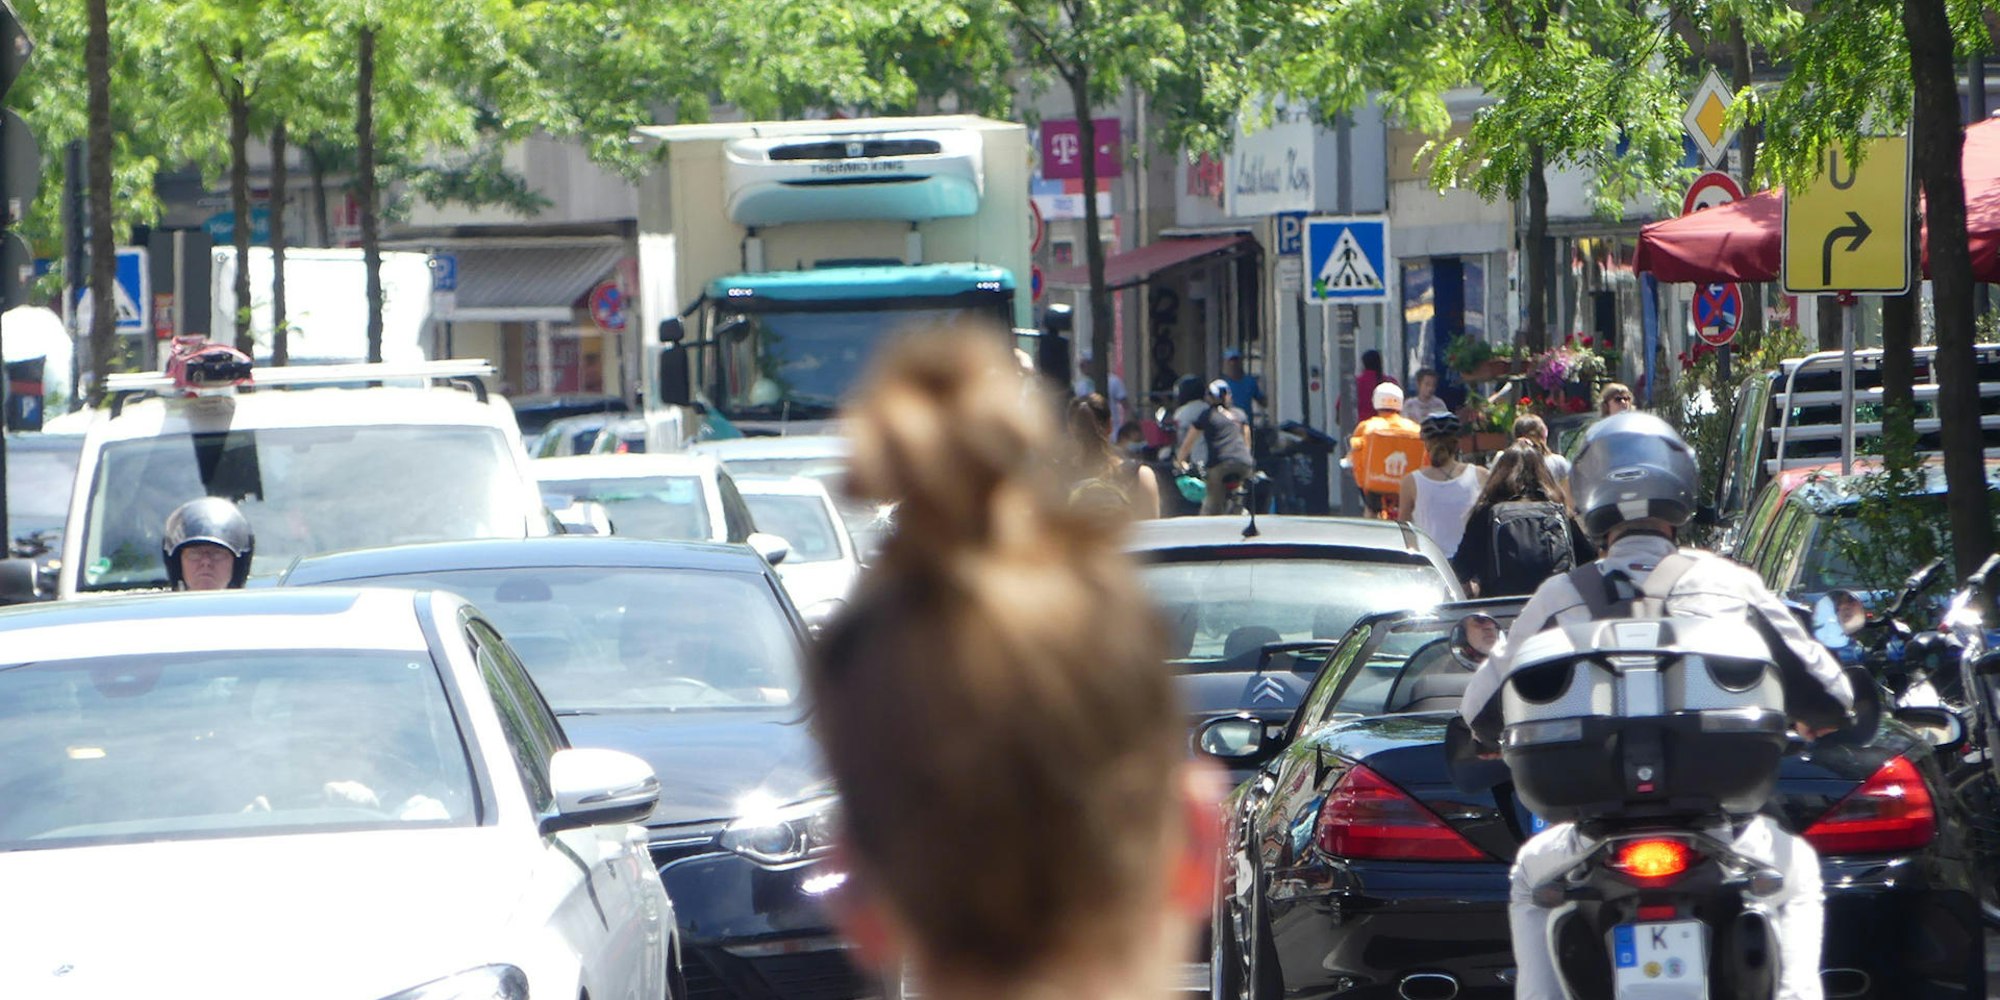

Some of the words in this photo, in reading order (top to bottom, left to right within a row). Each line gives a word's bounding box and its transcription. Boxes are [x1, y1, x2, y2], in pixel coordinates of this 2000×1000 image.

[1051, 133, 1078, 165] T
[1829, 150, 1856, 190] U
[1282, 216, 1299, 251] P
[1651, 926, 1668, 950] K
